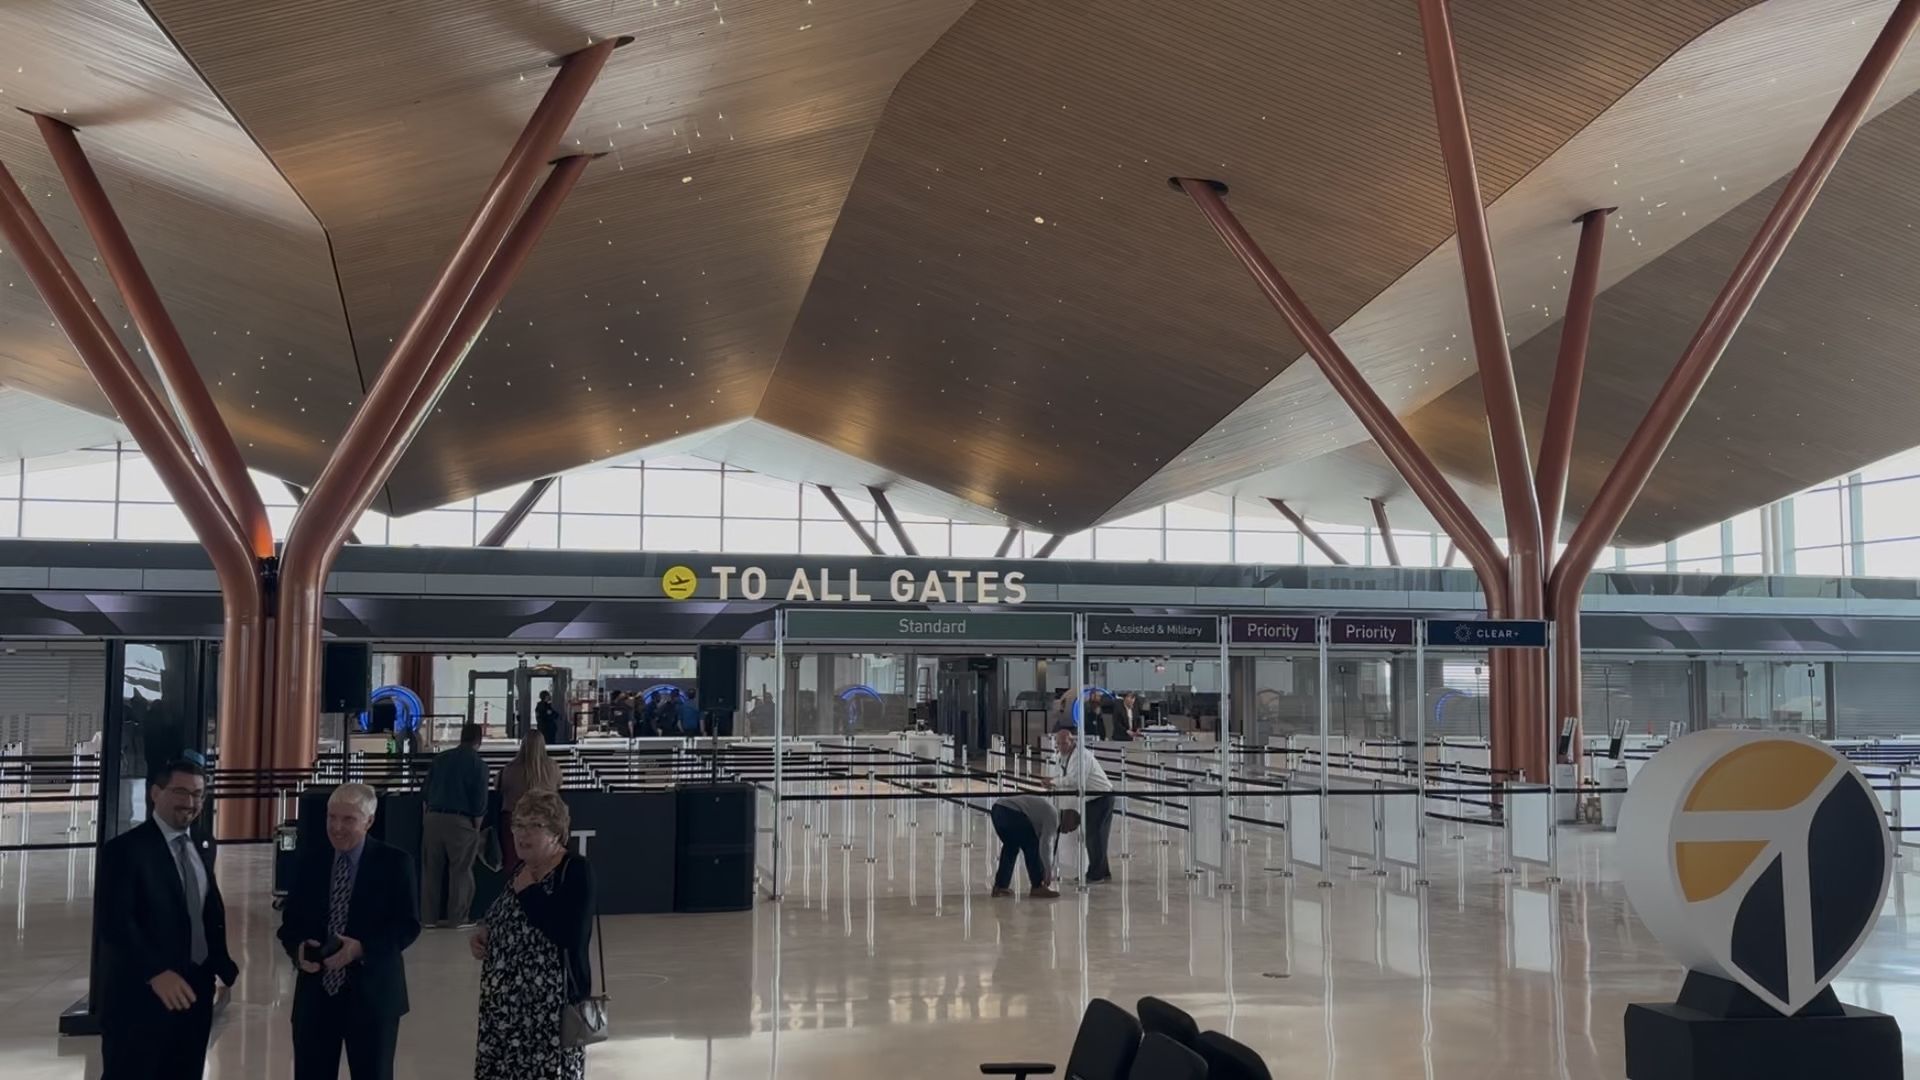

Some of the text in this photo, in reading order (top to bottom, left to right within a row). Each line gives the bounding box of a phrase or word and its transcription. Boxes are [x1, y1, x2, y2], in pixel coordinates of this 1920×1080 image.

[711, 566, 1027, 604] TO ALL GATES
[899, 617, 966, 634] Standard
[1115, 624, 1202, 637] Assisted & Military
[1247, 623, 1299, 641] Priority
[1346, 624, 1397, 642] Priority
